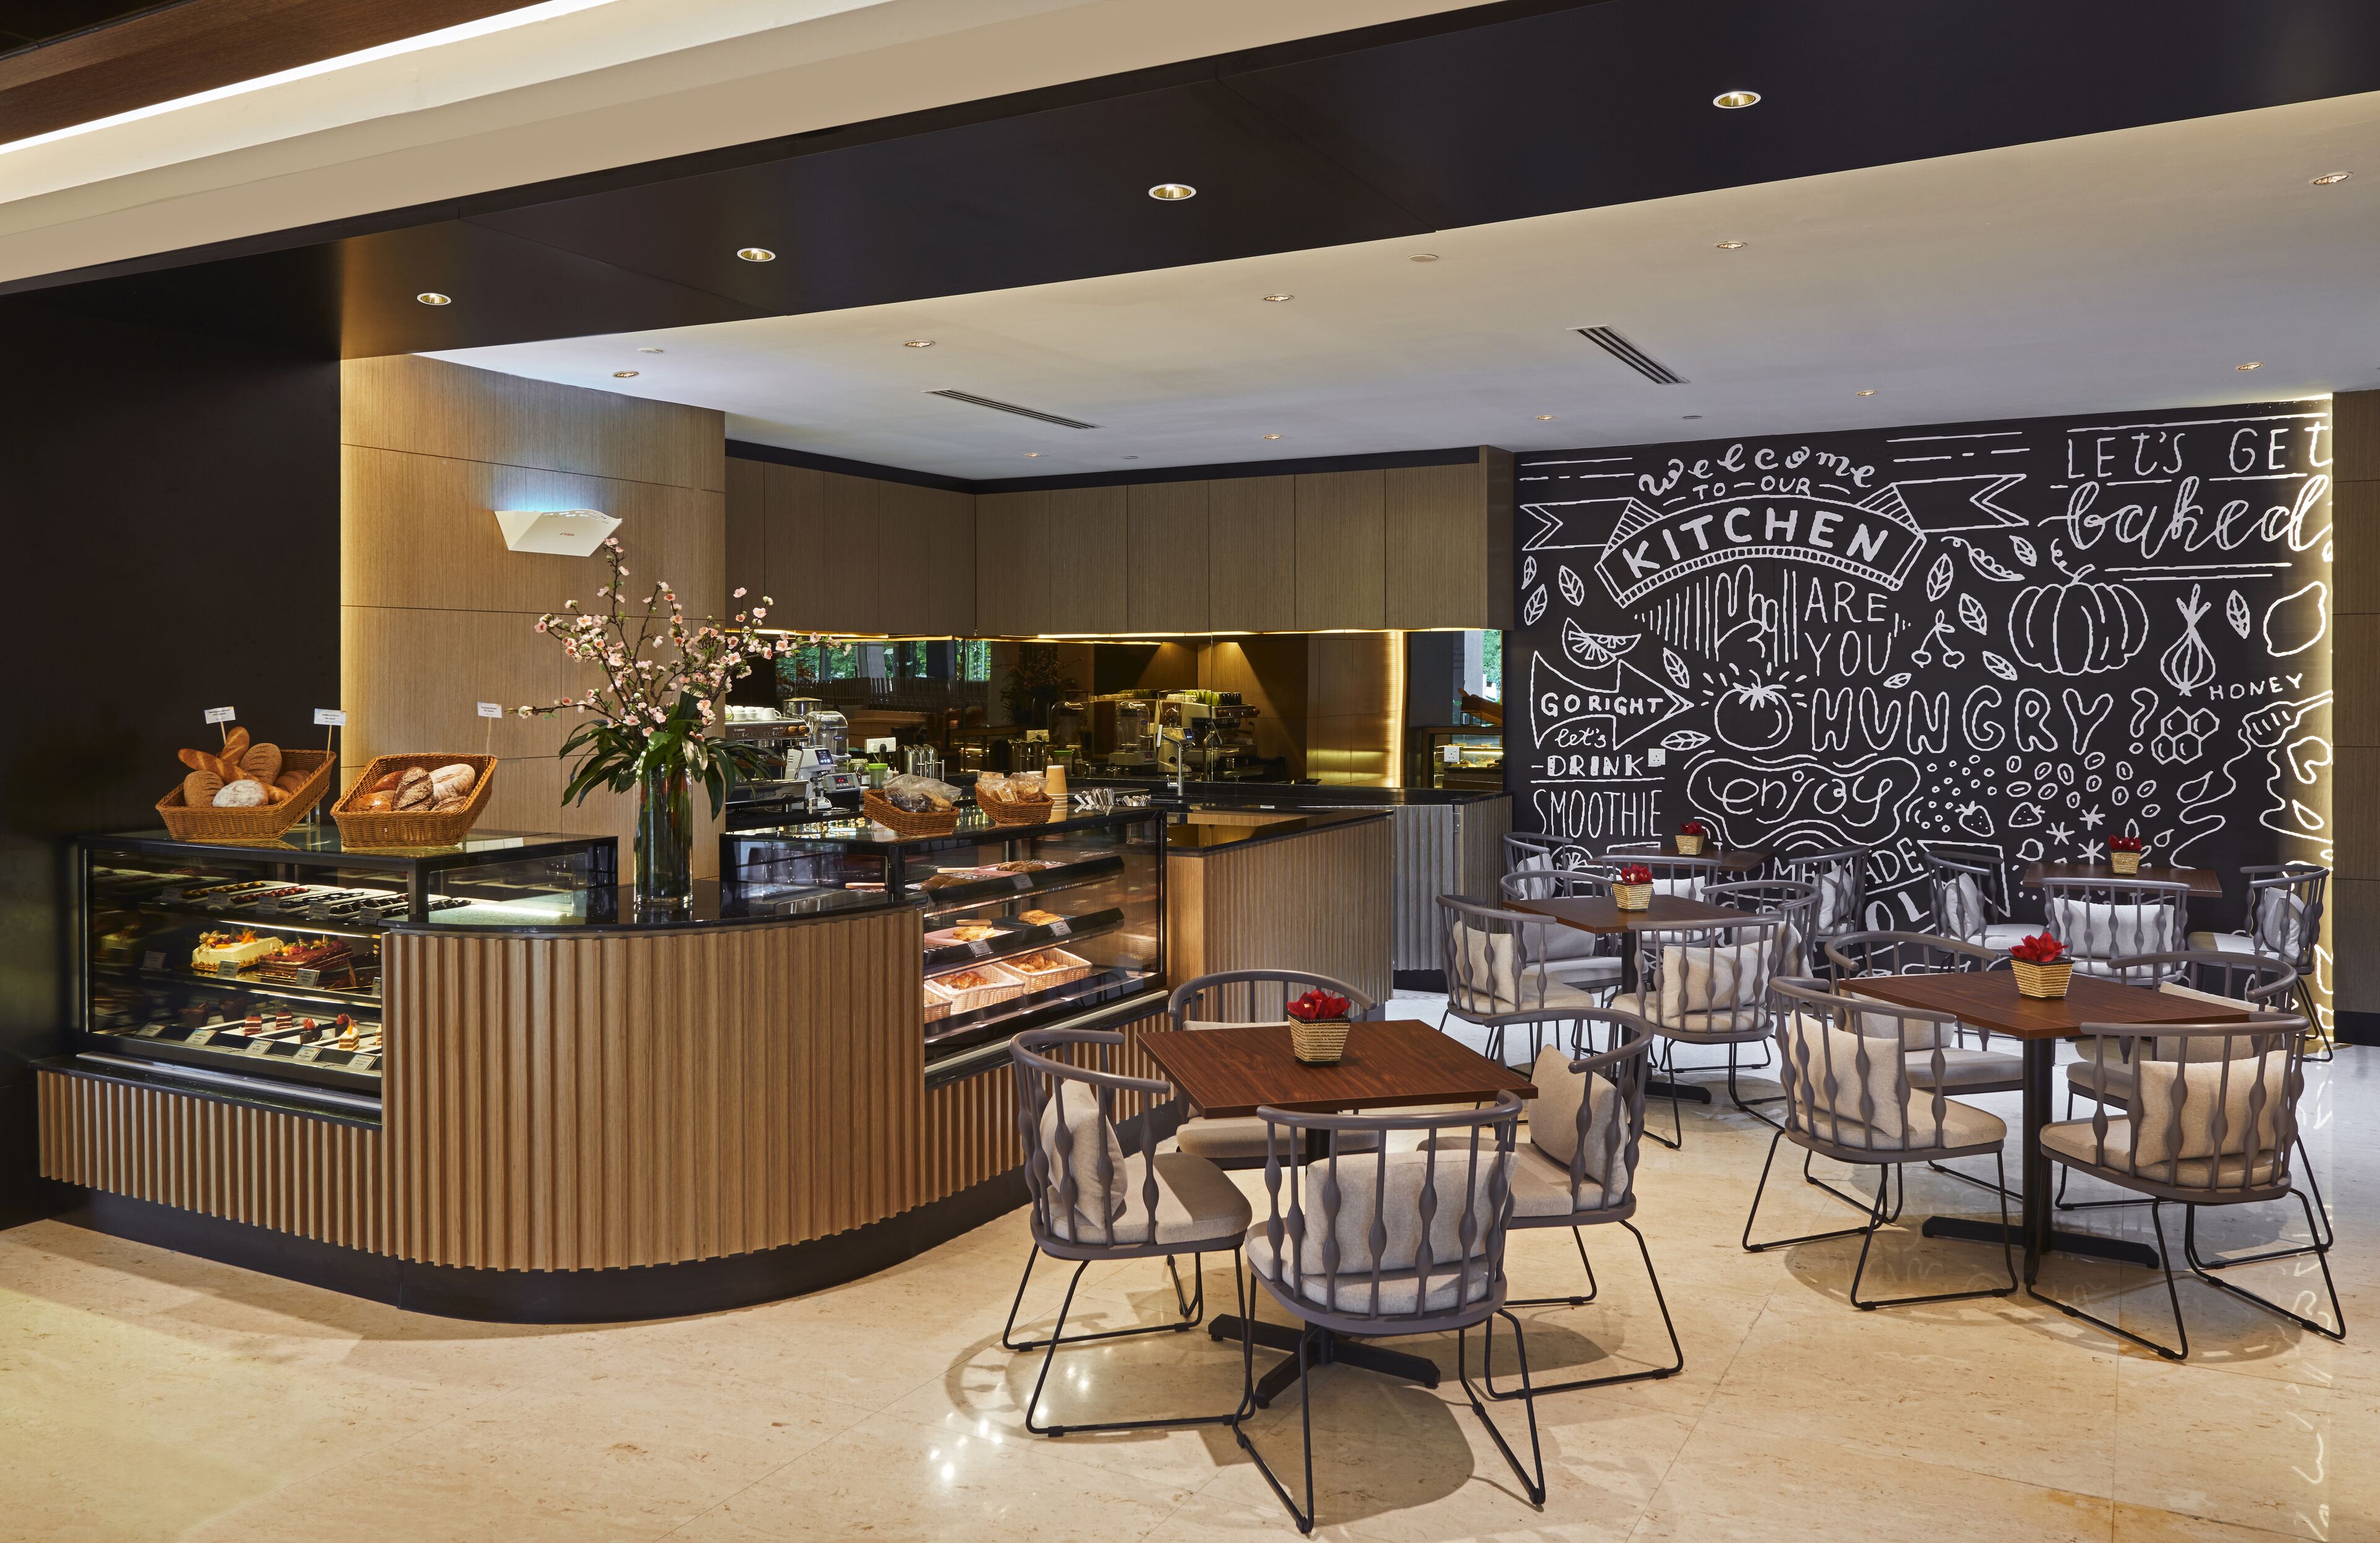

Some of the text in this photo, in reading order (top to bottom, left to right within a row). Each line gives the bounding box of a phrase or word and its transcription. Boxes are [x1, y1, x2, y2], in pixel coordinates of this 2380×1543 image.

[1692, 477, 1811, 500] TO OUR
[2037, 475, 2334, 560] baked
[1622, 507, 1889, 579] KITCHEN
[1804, 577, 1888, 623] ARE
[1804, 630, 1893, 677] YOU
[1541, 692, 1664, 718] GO RIGHT
[2209, 672, 2303, 701] HONEY
[1547, 754, 1644, 777] DRINK
[1533, 789, 1663, 838] SMOOTHIE
[1708, 770, 1893, 827] enjoy
